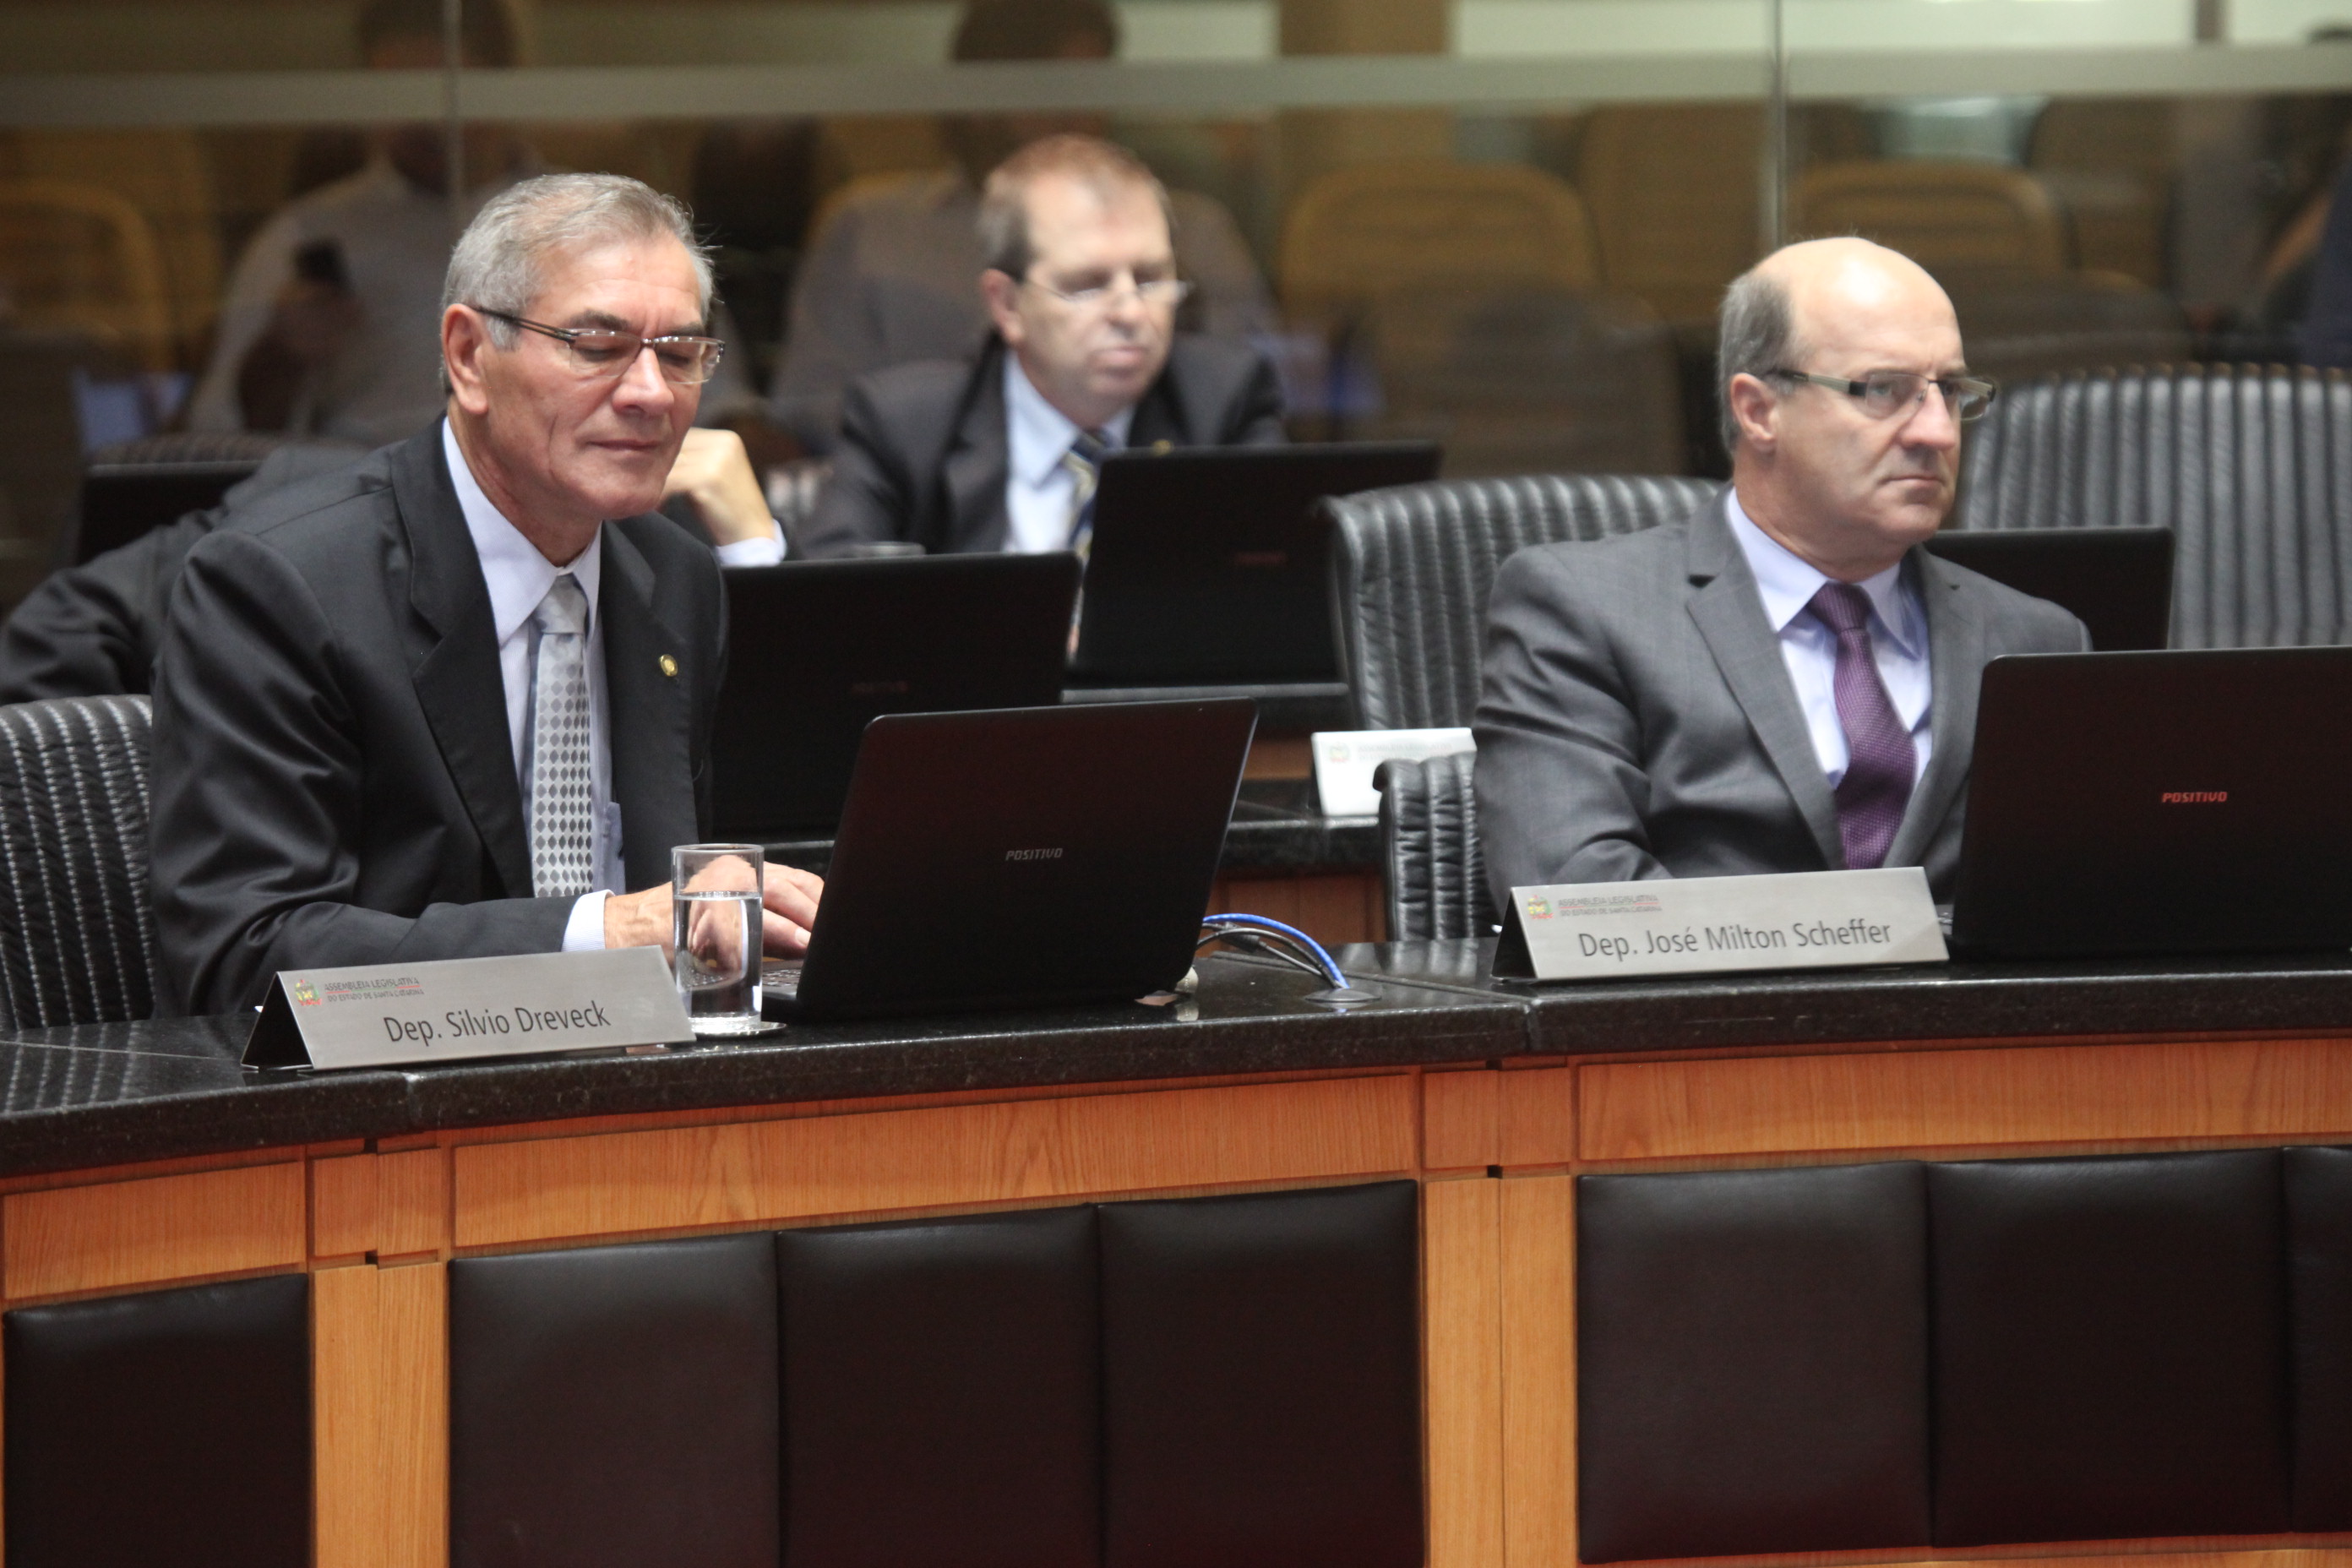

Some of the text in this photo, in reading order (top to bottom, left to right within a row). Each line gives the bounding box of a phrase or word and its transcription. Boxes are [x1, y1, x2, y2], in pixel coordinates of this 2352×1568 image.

[2163, 792, 2228, 803] POSITIVO
[1005, 847, 1063, 861] POSITIVO
[1578, 918, 1892, 962] Dep. José Milton Scheffer
[324, 977, 419, 991] ASSEMBLEIA LEGISLATIVA
[384, 1000, 612, 1046] Dep. Silvio Dreveck
